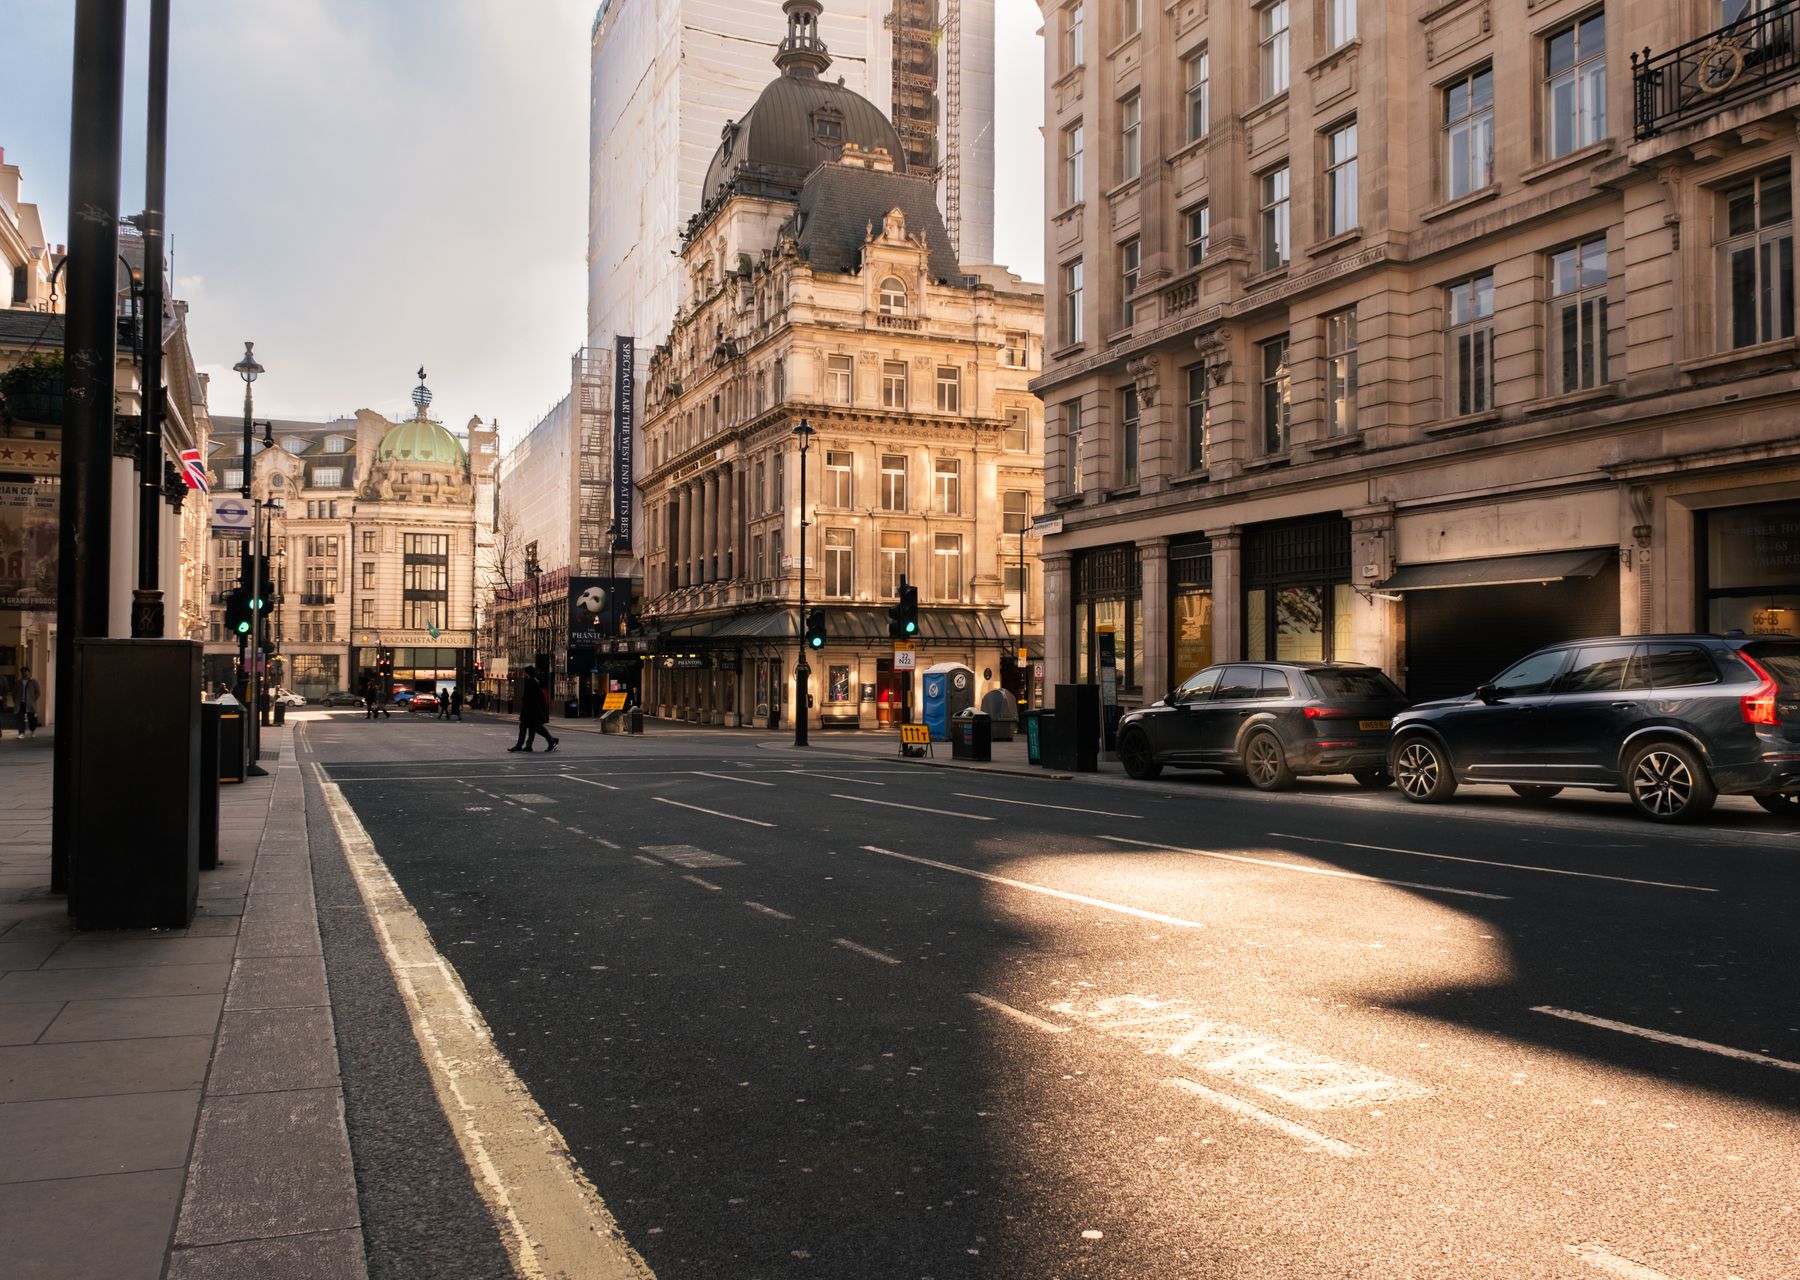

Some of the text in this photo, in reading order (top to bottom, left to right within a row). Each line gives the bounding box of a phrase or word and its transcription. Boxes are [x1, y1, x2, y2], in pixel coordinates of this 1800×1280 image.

[620, 343, 631, 542] SPECTACULAR! THE WEST END AT ITS BEST
[0, 486, 39, 496] IAN COX
[1781, 522, 1800, 534] HO
[572, 631, 606, 639] PHANT
[383, 636, 468, 645] KAZAKHSTAN HOUSE
